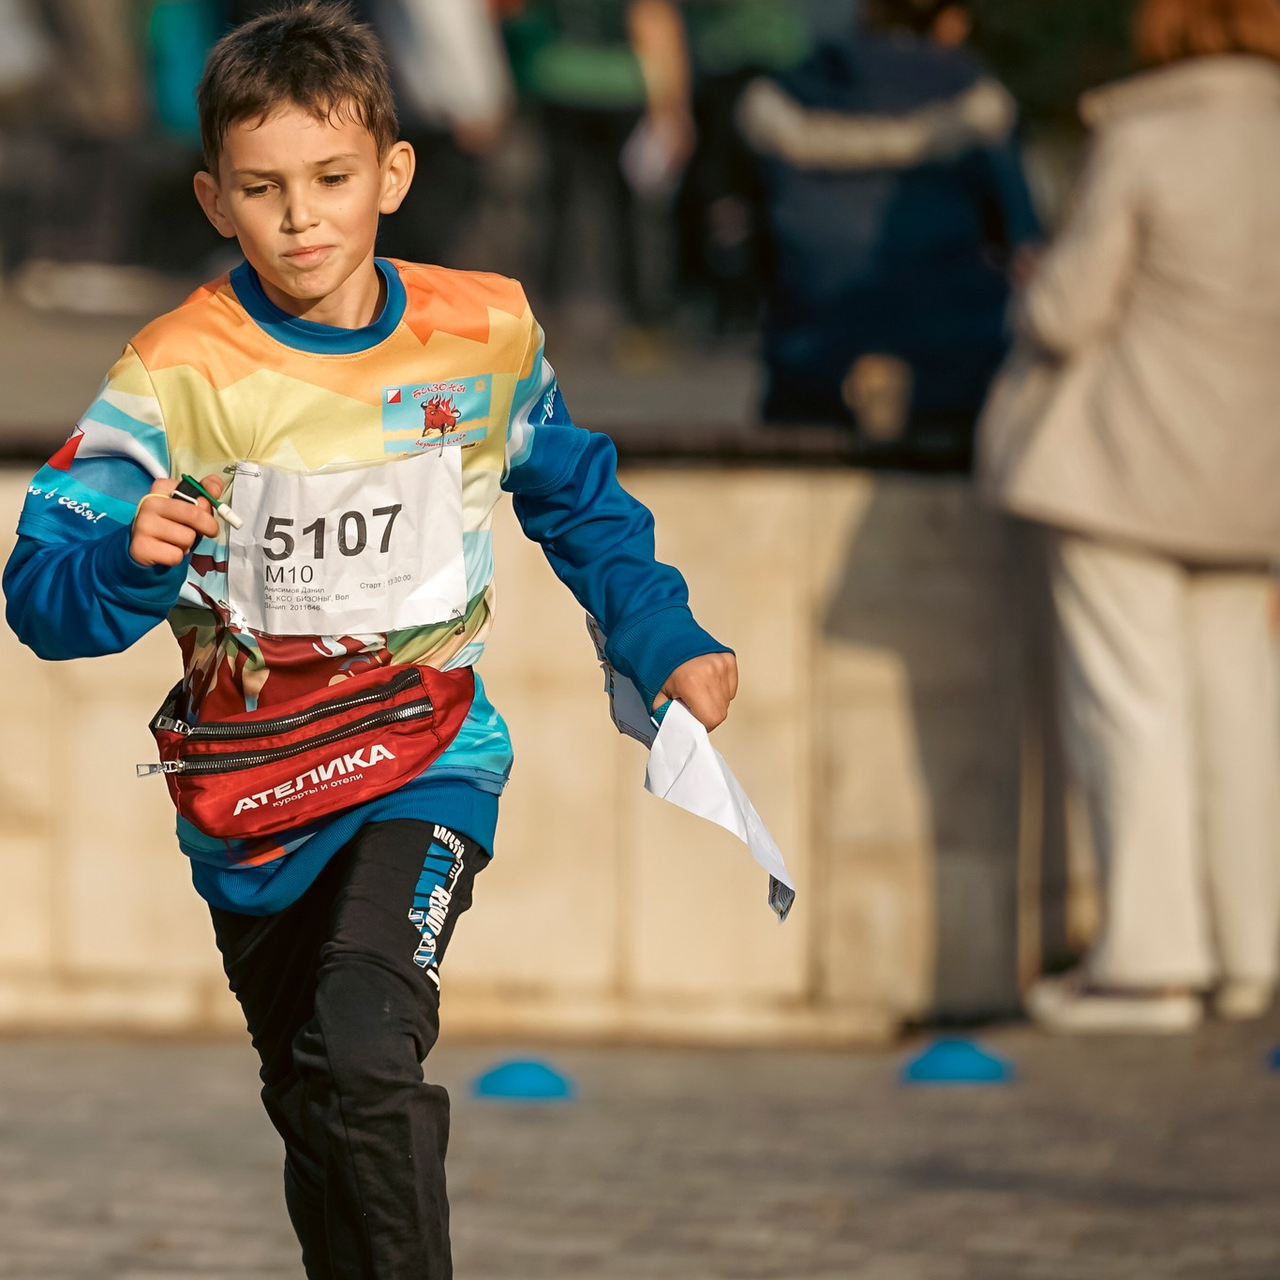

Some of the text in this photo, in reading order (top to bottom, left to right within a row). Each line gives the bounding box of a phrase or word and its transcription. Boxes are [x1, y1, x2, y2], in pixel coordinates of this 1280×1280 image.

[58, 496, 107, 524] себя!
[263, 503, 403, 561] 5107
[359, 582, 382, 590] Старт
[232, 743, 396, 816] АТЕЛИКА
[272, 773, 363, 808] курорты и отели
